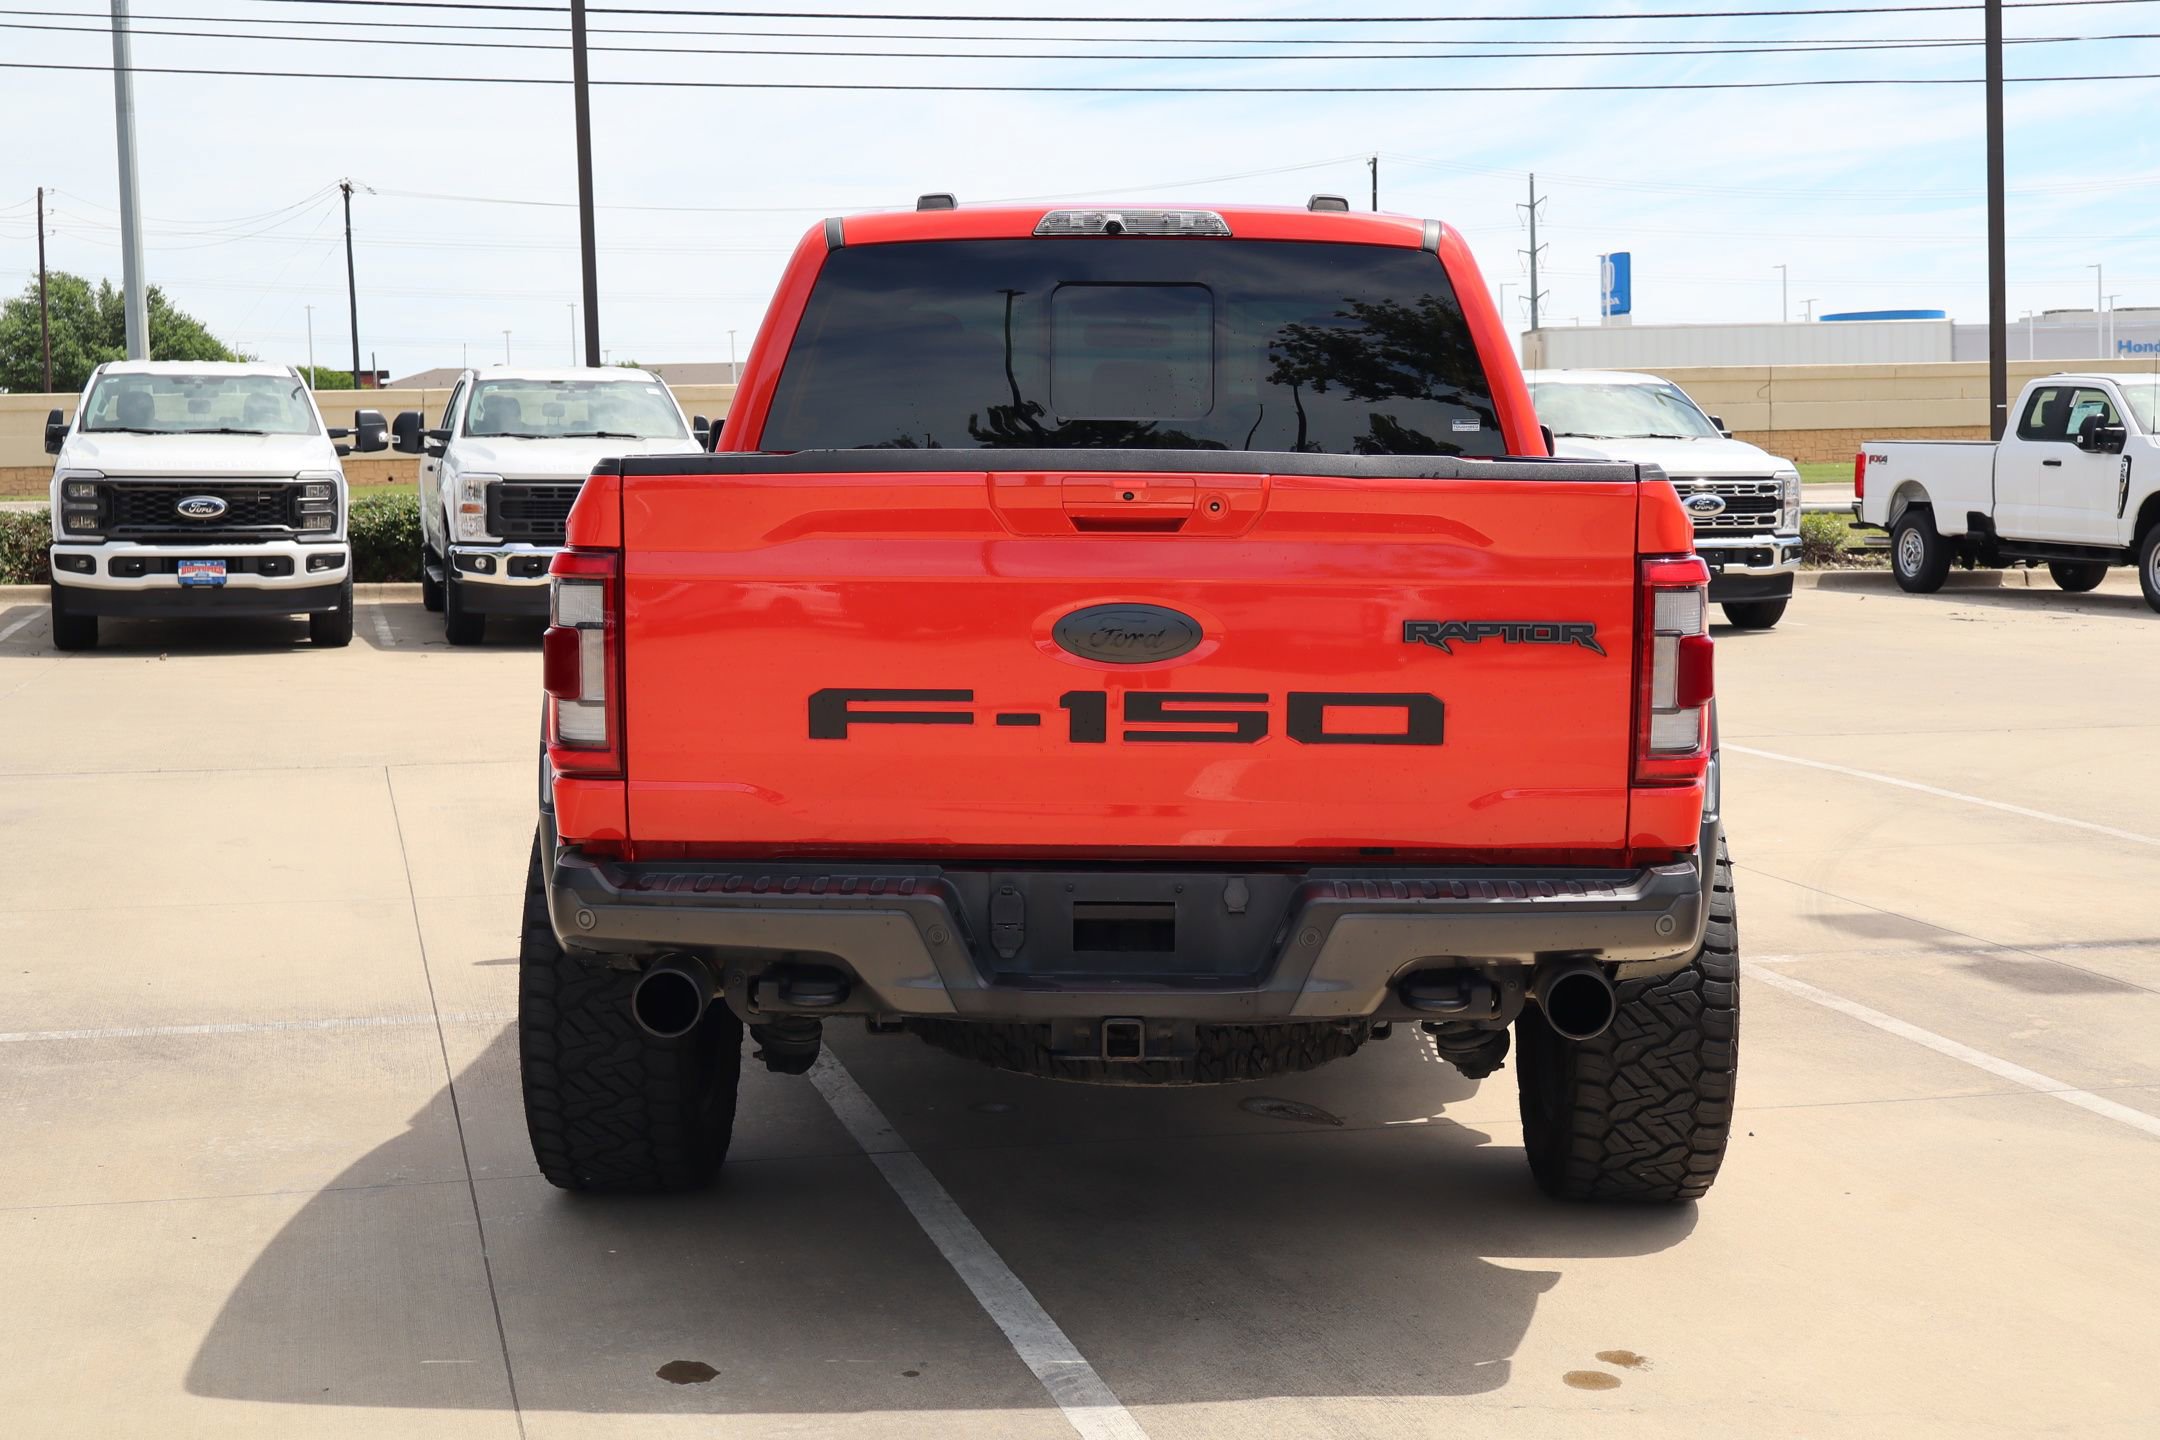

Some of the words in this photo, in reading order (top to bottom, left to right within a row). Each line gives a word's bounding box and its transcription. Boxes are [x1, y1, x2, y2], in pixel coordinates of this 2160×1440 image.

[189, 502, 213, 513] Ford
[1088, 616, 1166, 649] Ford
[1403, 620, 1607, 657] RAPTOR
[809, 688, 1444, 745] F-150
